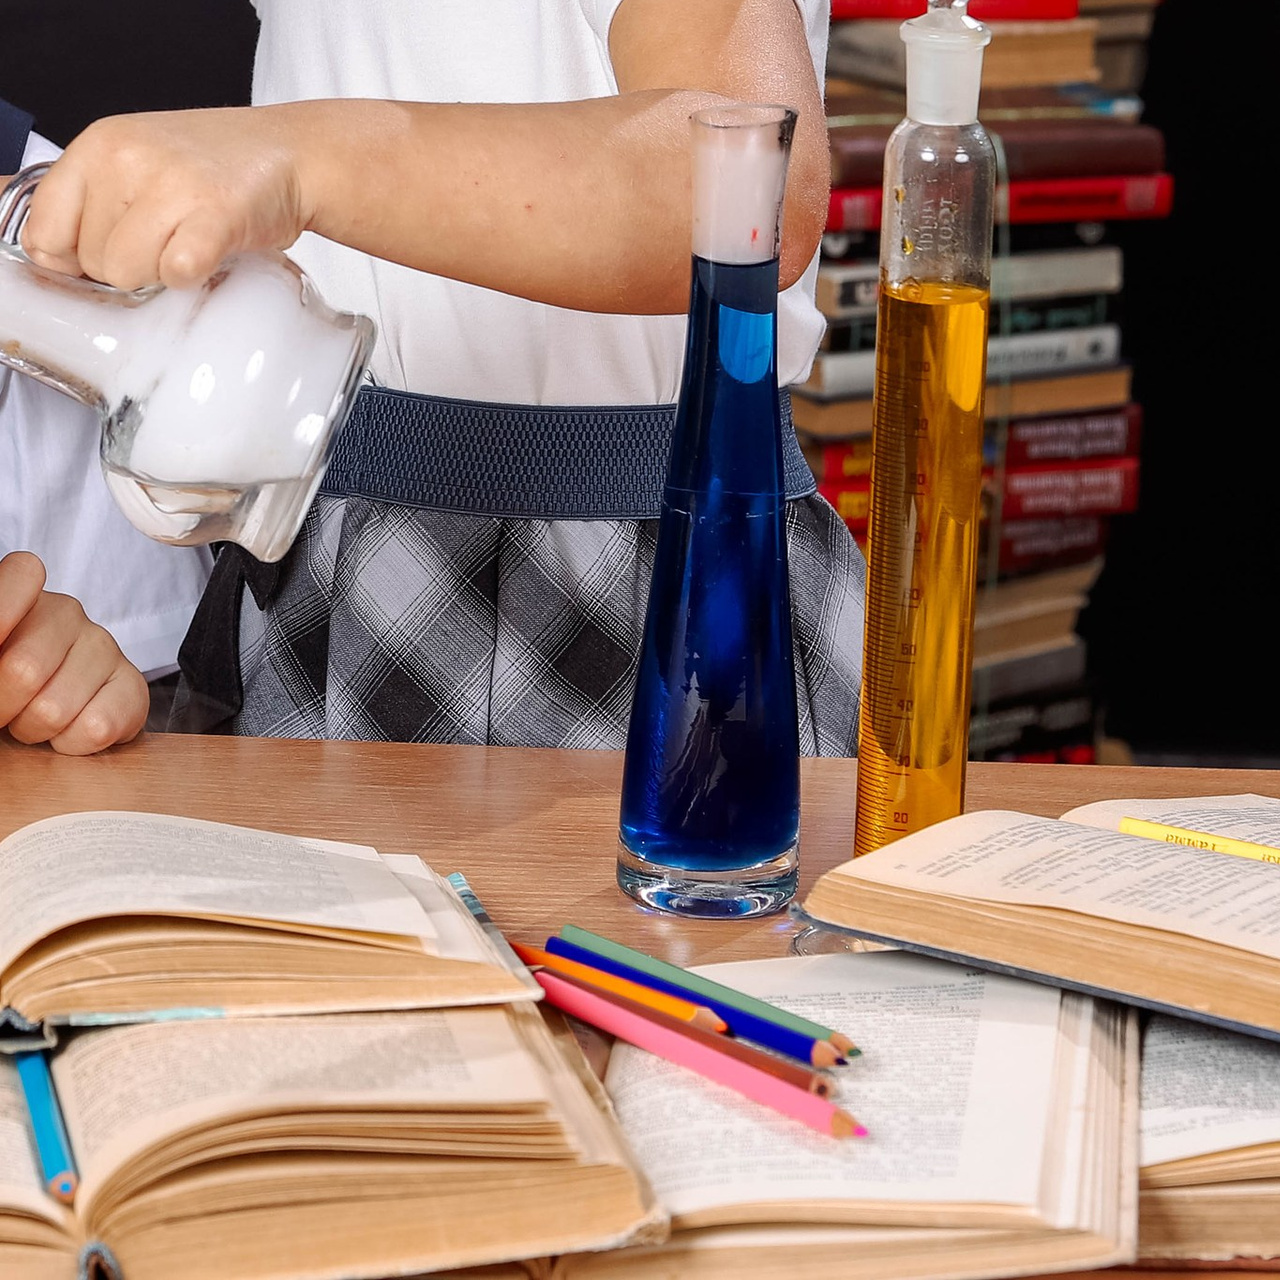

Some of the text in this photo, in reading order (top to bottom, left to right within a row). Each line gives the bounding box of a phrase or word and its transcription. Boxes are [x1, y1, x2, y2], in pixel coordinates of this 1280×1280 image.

[901, 643, 916, 655] 50
[898, 699, 913, 711] 40
[893, 812, 909, 824] 20
